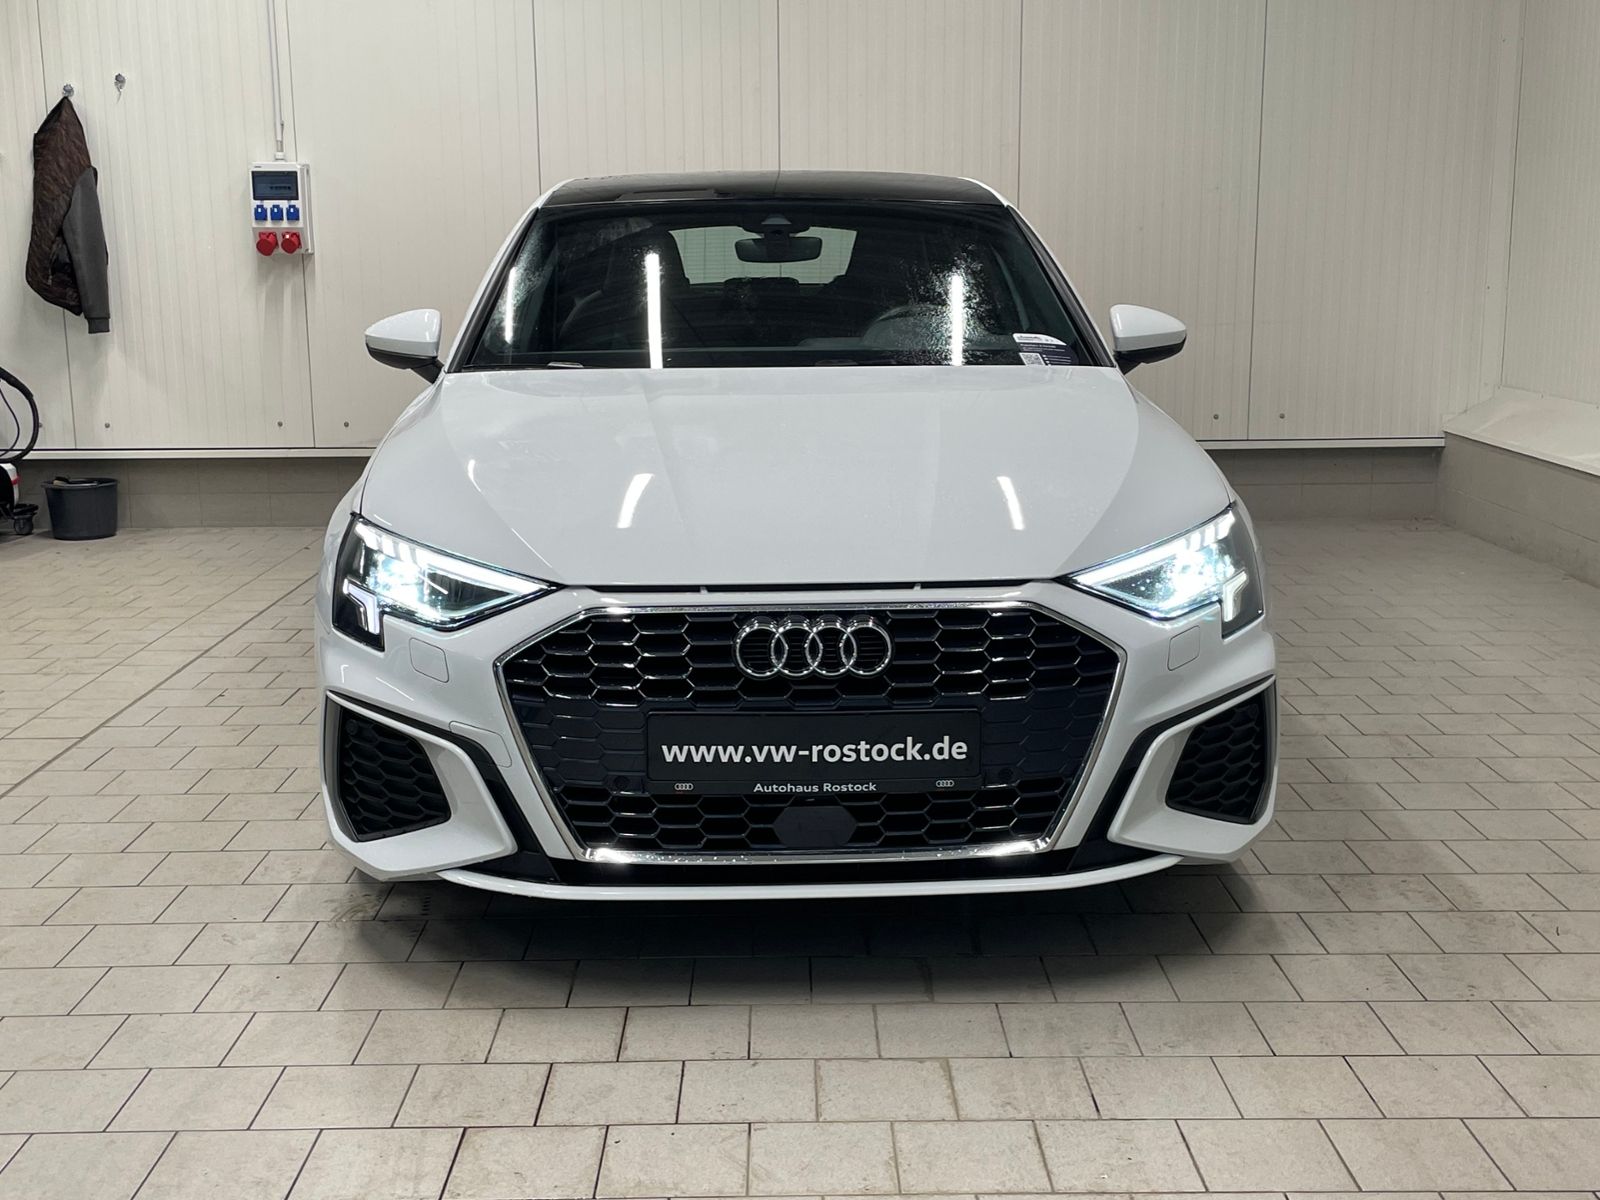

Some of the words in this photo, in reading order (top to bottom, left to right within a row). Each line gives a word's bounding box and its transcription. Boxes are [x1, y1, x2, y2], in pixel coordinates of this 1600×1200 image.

[661, 735, 968, 763] www.vw-rostock.de
[753, 782, 819, 793] Autohaus
[823, 782, 877, 792] Rostock
